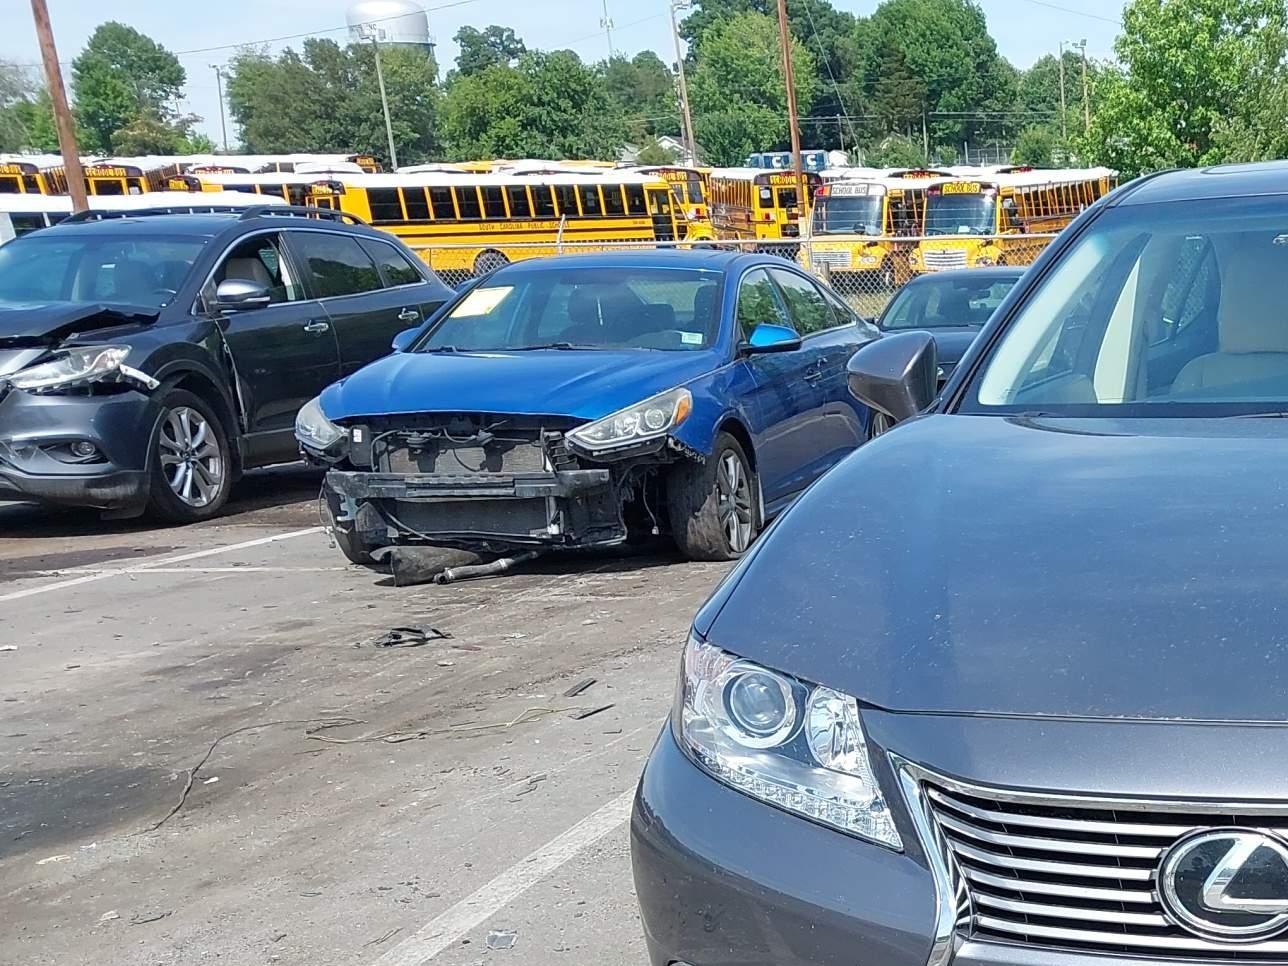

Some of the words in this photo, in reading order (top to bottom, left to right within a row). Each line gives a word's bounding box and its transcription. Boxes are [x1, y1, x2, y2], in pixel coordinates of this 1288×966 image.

[832, 185, 853, 194] SCHOOL
[854, 185, 867, 194] BUS
[944, 183, 965, 193] SCHOOL
[966, 183, 979, 193] BUS
